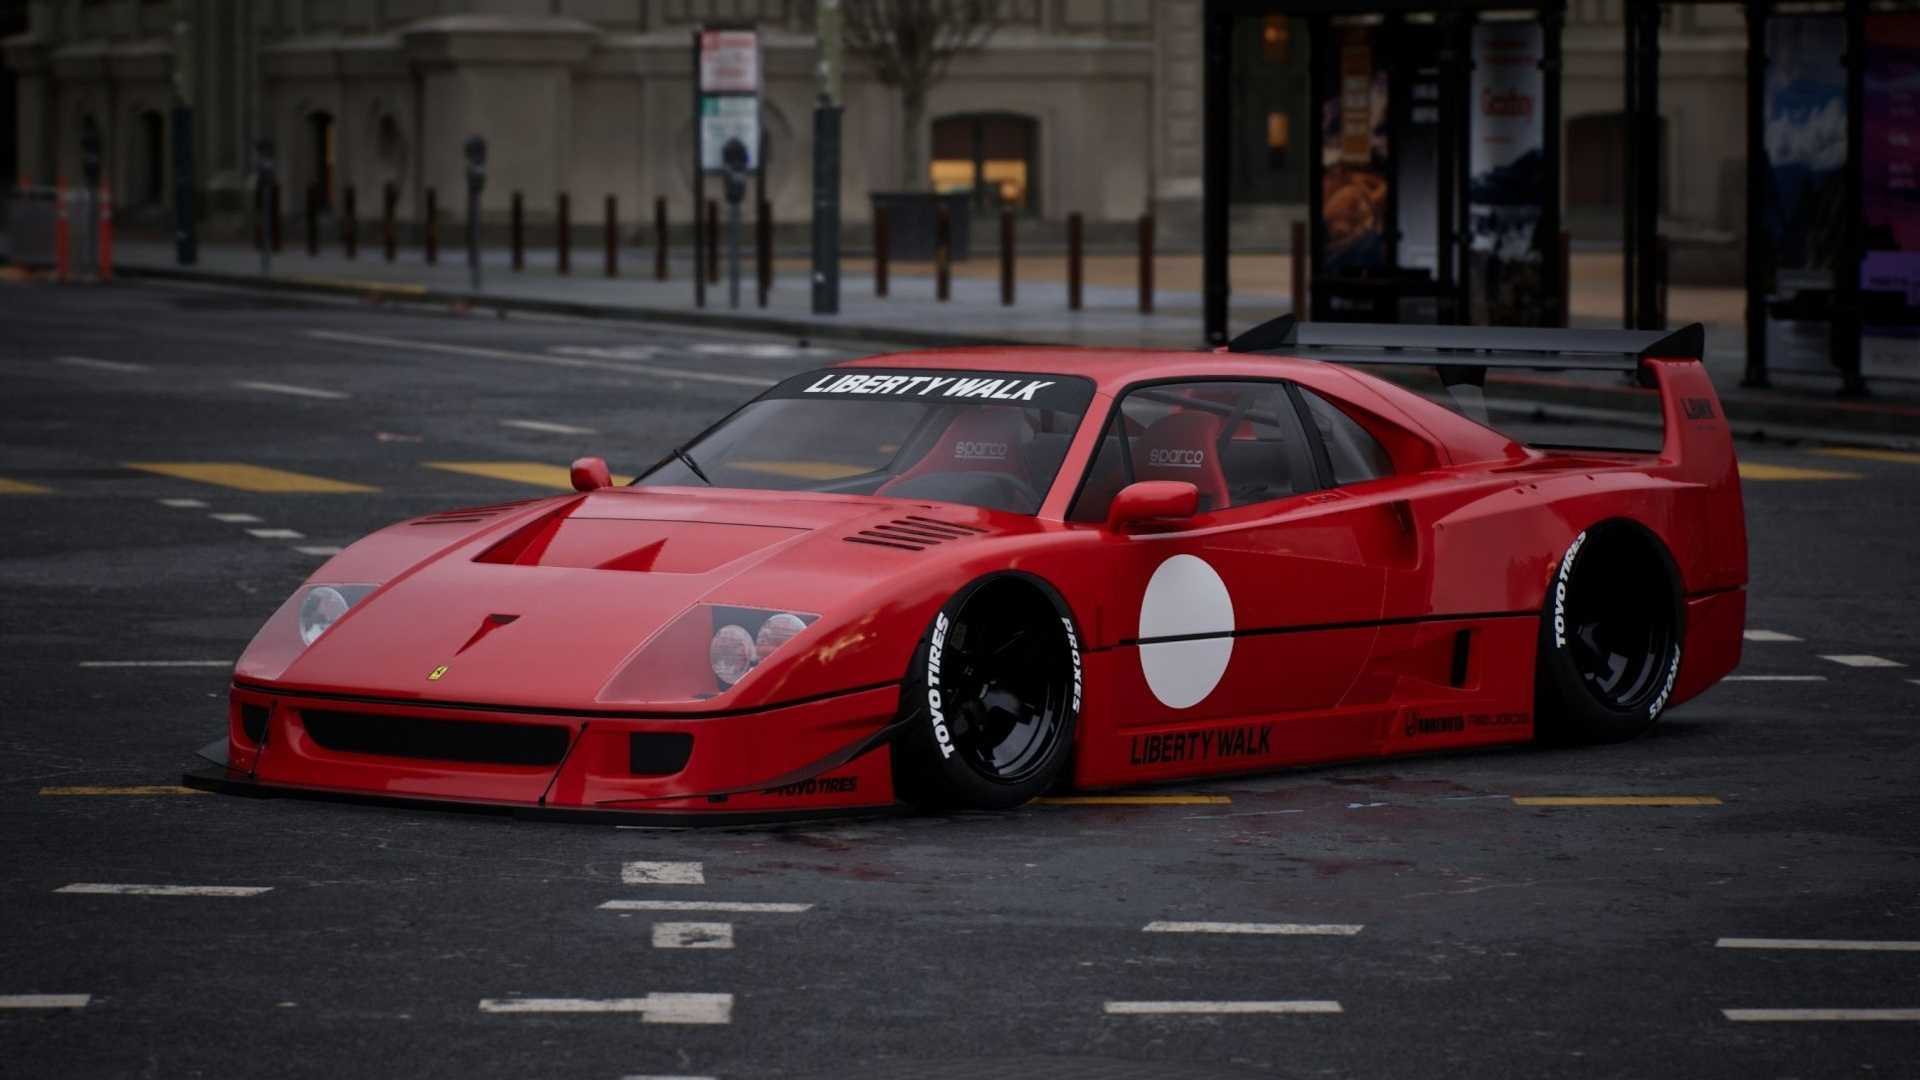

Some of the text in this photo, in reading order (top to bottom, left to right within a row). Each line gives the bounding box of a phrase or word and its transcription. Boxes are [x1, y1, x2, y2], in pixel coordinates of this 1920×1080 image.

[803, 374, 1057, 401] LIBERTY WALK
[955, 441, 1008, 459] sparco
[1149, 448, 1204, 467] sparco
[1555, 581, 1568, 648] TOYO
[1061, 616, 1082, 714] PROXES
[928, 611, 956, 760] TOYO TIRES
[1130, 725, 1273, 765] LIBERTY WALK
[818, 775, 859, 793] TIRES
